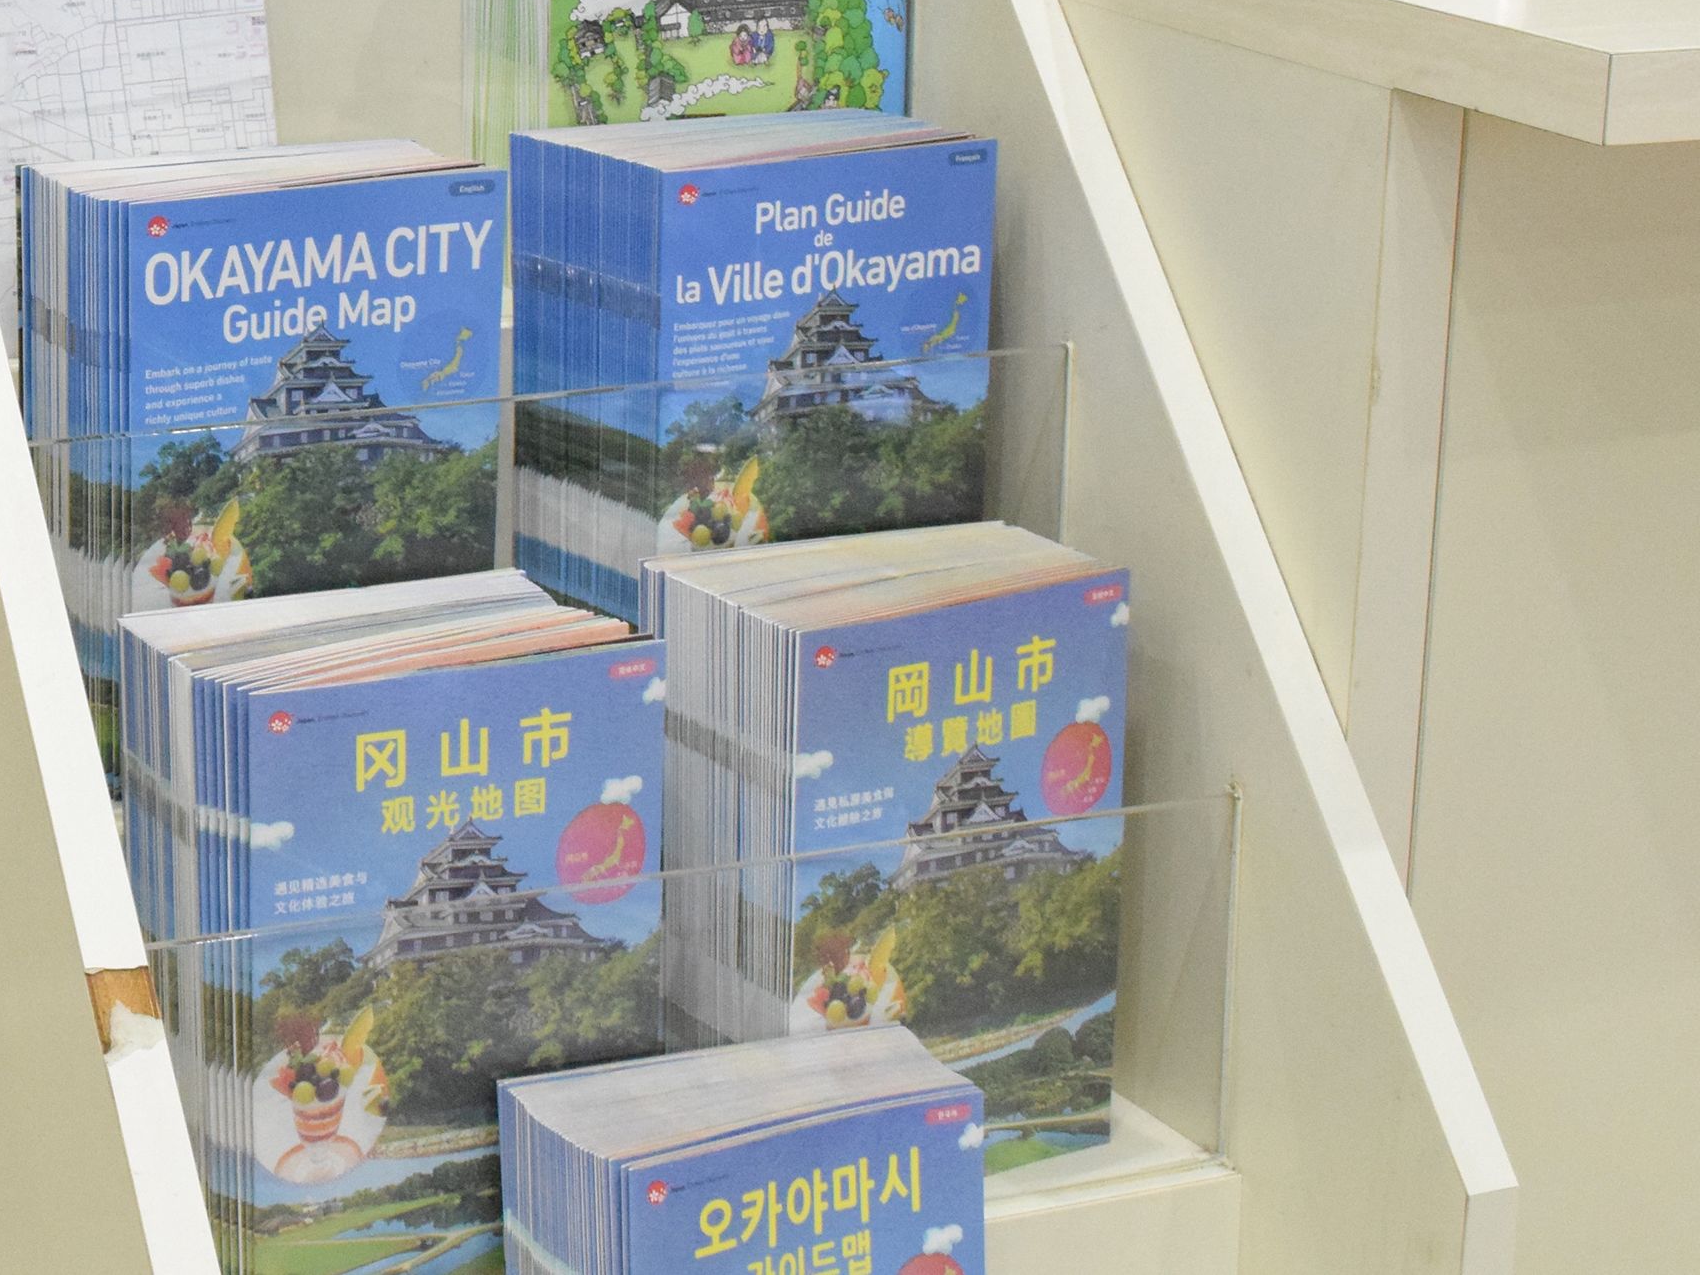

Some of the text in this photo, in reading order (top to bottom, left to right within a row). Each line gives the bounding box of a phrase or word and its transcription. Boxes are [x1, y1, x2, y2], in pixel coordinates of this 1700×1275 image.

[755, 186, 906, 236] Plan Guide
[144, 219, 494, 306] OKAYAMA CITY
[813, 229, 834, 249] de
[676, 242, 982, 307] la Ville d'Okayama
[222, 286, 418, 345] Guide Map
[145, 366, 181, 380] Embark
[183, 366, 195, 375] on
[204, 360, 237, 374] journey
[240, 356, 249, 367] of
[250, 355, 273, 366] taste
[145, 373, 246, 395] through superb dishes
[145, 399, 164, 410] and
[165, 393, 215, 408] experience
[145, 405, 237, 425] richly unique culture
[886, 635, 1058, 725] 岡山市
[356, 706, 573, 793] 冈山市
[381, 777, 548, 835] 观光地图
[273, 892, 356, 916] 文化体验之旅
[693, 1145, 921, 1260] 오카야마시
